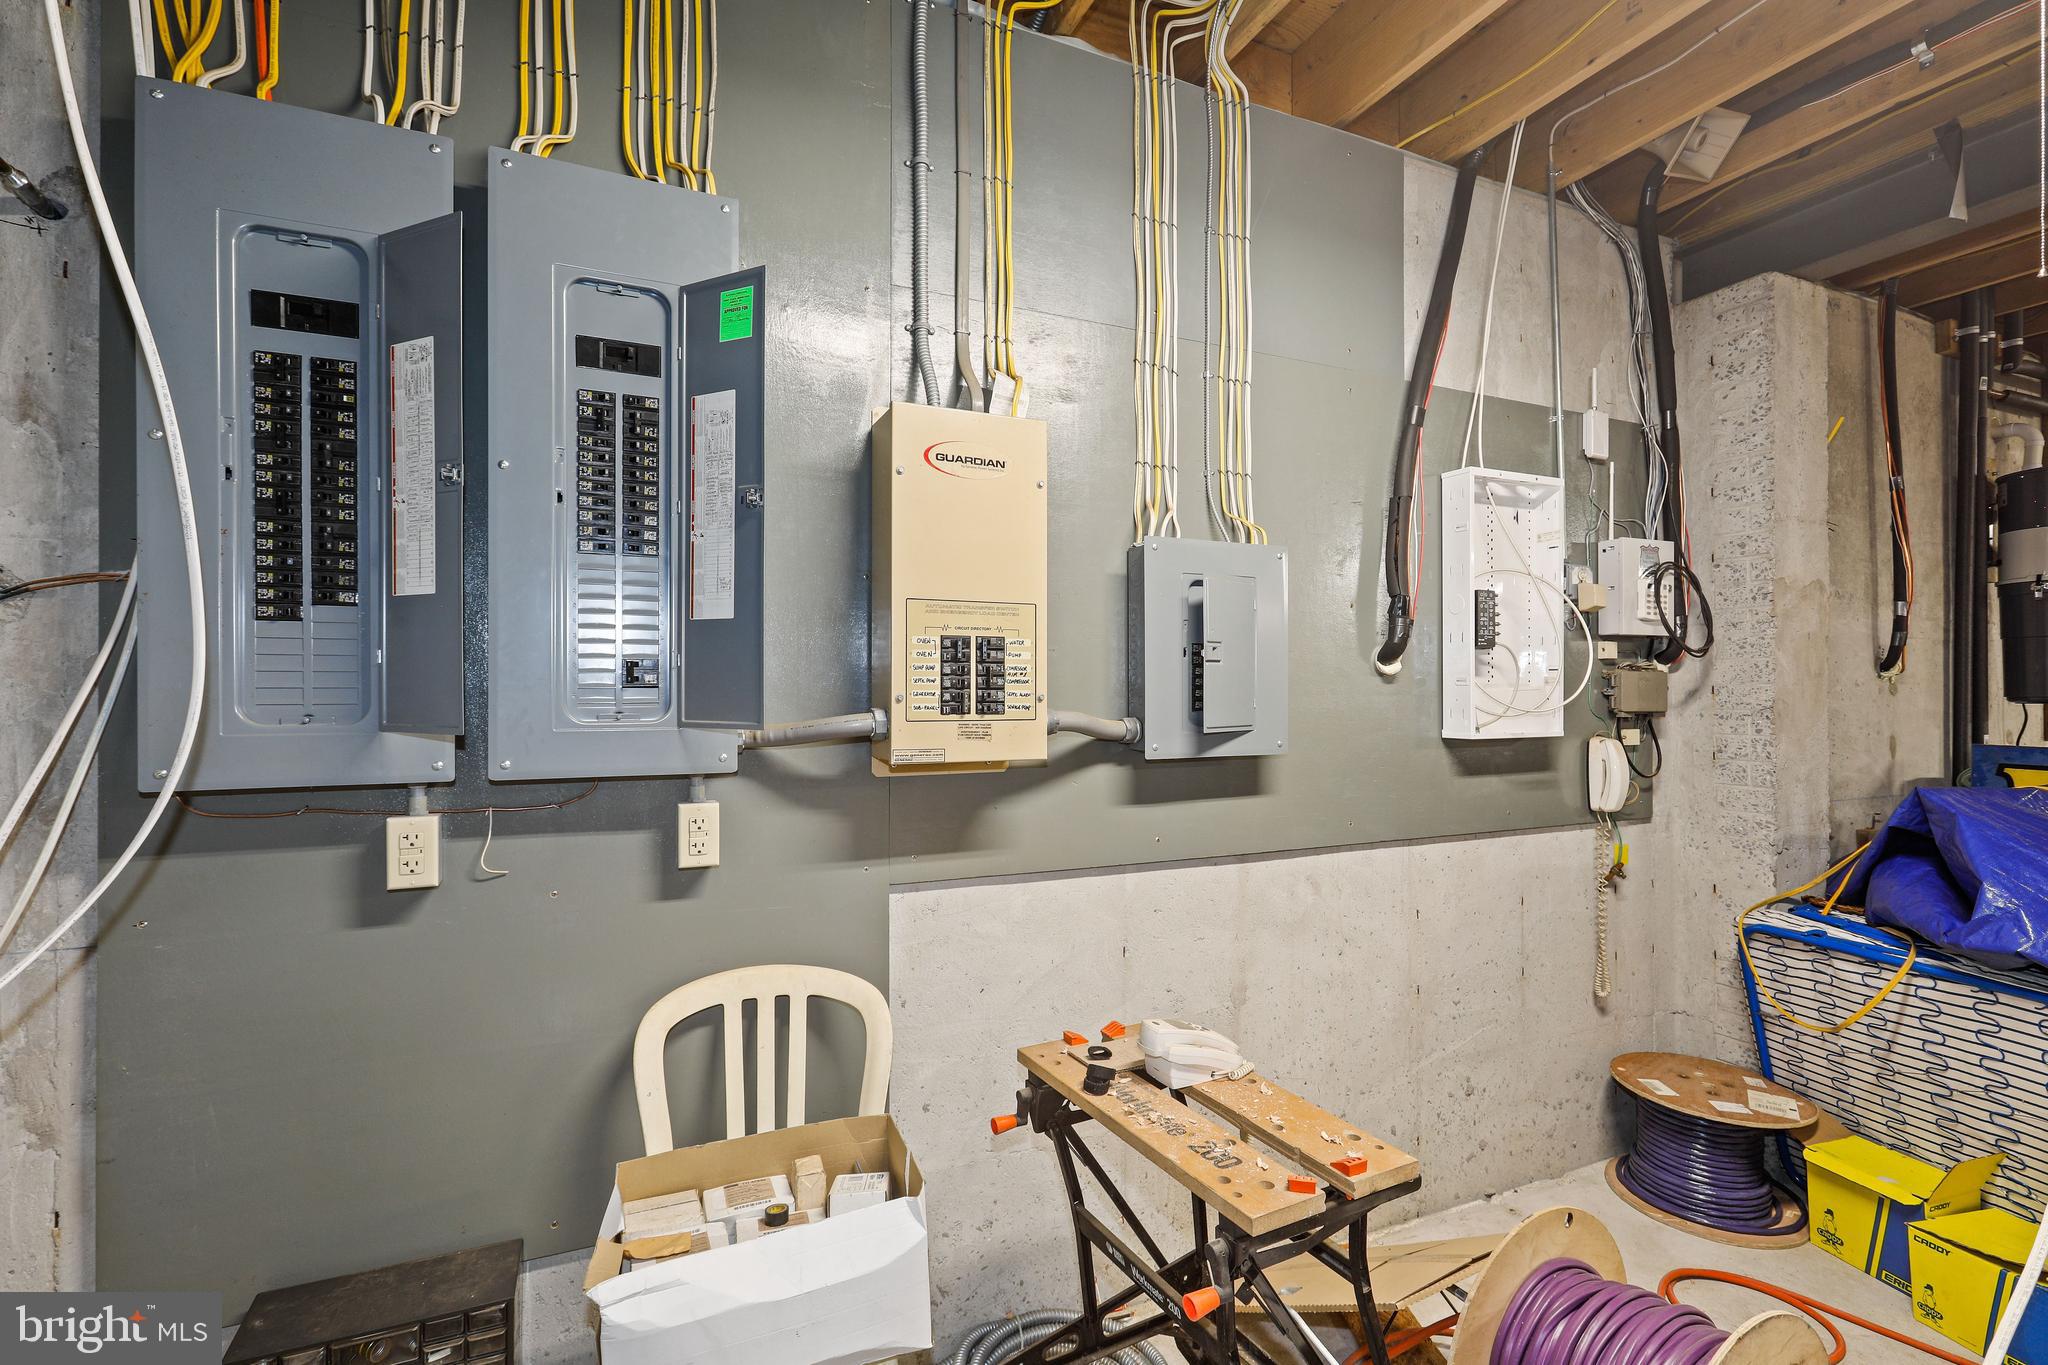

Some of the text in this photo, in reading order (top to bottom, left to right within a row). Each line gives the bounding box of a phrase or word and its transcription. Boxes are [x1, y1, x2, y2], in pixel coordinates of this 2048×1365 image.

[935, 452, 1006, 468] GUARDIAN
[1188, 1140, 1243, 1170] 200
[1929, 1201, 1951, 1212] CADDY
[1818, 1228, 1842, 1246] CADDY
[1913, 1234, 1952, 1257] CADDY
[1130, 1264, 1182, 1320] Workmate 200
[1918, 1302, 1942, 1320] CADDY
